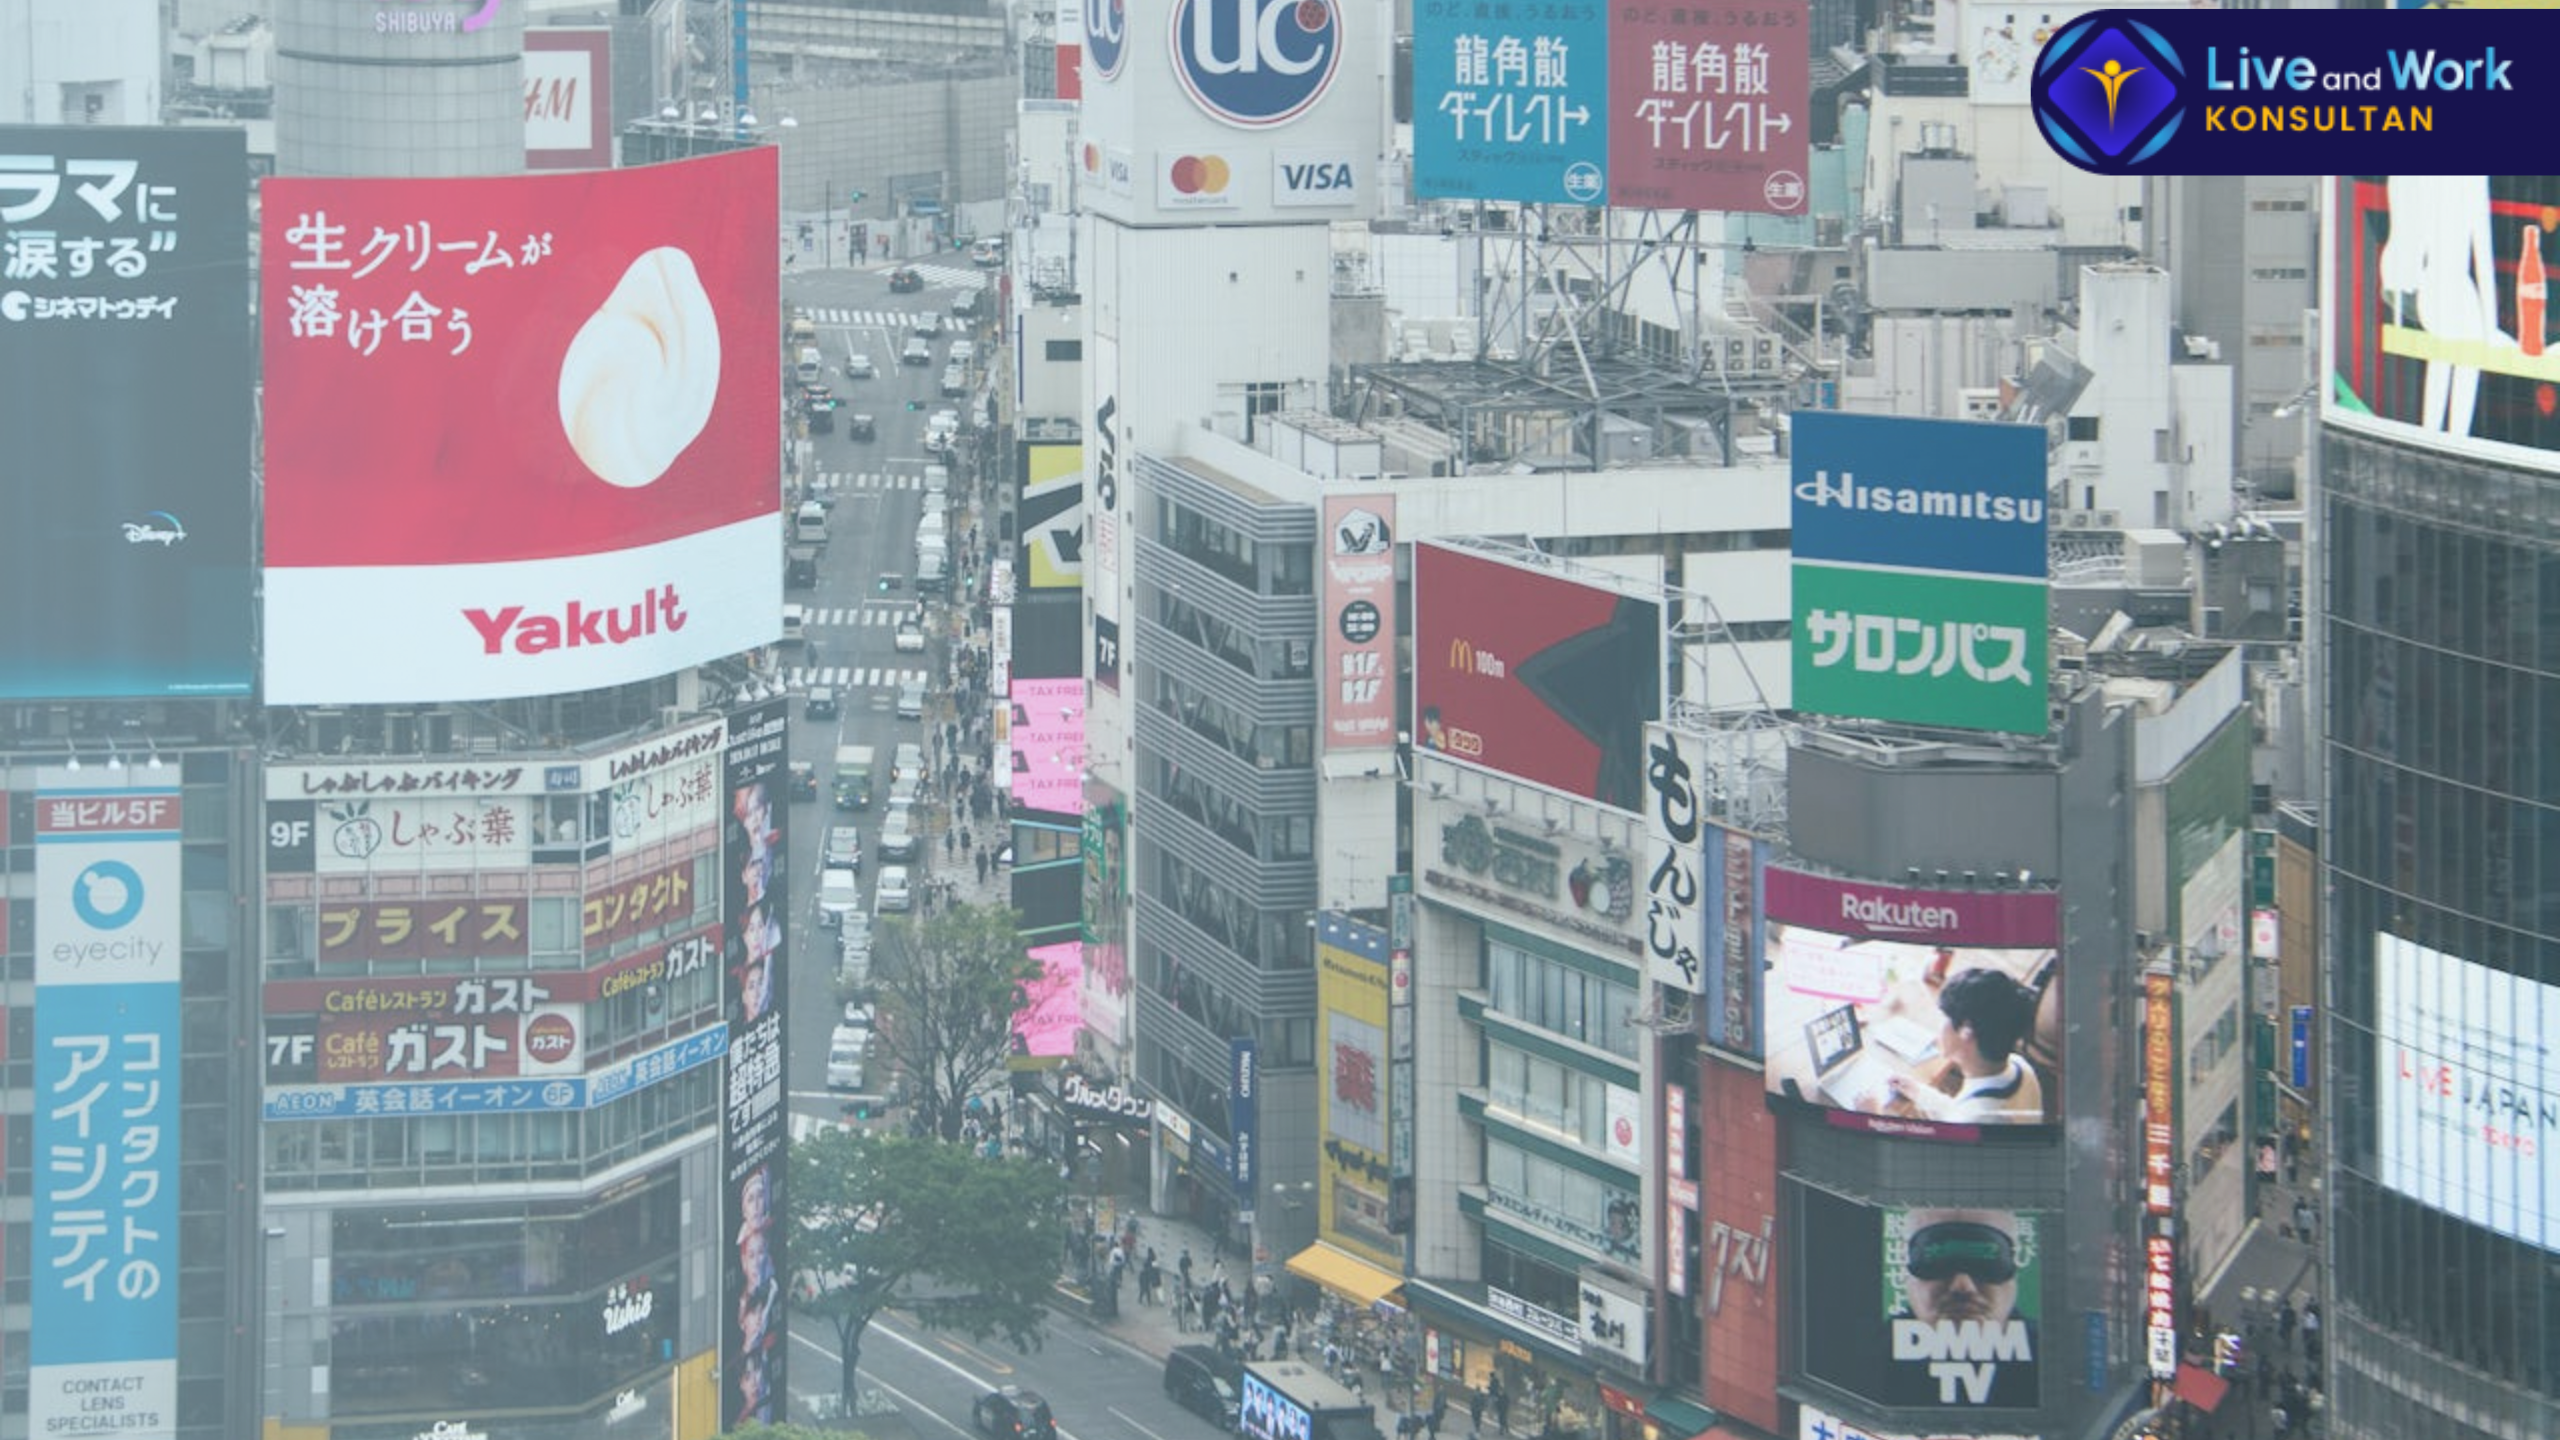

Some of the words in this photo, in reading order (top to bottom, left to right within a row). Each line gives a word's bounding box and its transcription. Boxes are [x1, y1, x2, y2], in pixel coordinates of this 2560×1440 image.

[375, 11, 455, 32] SHIBUYA
[1455, 34, 1569, 87] 龍角散
[1652, 40, 1770, 94] 龍角散
[1439, 91, 1590, 144] ダイレクト
[1634, 99, 1792, 152] ダイレクト
[1281, 163, 1353, 190] VISA
[285, 211, 552, 280] 生クリームが
[288, 284, 473, 356] 溶け合う
[1795, 470, 2043, 524] Hisamitsu
[461, 582, 688, 655] Yakult
[1100, 637, 1116, 667] 7F
[1806, 608, 2034, 687] サロンパス
[610, 726, 722, 780] しゃぶしゃぶバイキング
[302, 768, 523, 794] しゃぶしゃぶバイキング
[51, 800, 167, 828] 当ビル5F
[270, 821, 309, 847] 9F
[391, 807, 515, 846] しゃぶ葉
[1648, 733, 1698, 985] もんじゃ
[585, 869, 689, 935] コンタクト
[1841, 893, 1958, 929] Rakuten
[322, 905, 519, 947] プライス
[52, 936, 163, 969] eyecity
[666, 936, 715, 981] ガスト
[454, 978, 550, 1014] ガスト
[267, 1035, 314, 1065] 7F
[325, 1032, 380, 1054] Café
[327, 1054, 380, 1069] レストラン
[386, 1024, 507, 1073] ガスト
[532, 1035, 571, 1050] ガスト
[2400, 1049, 2453, 1097] LVE
[355, 1086, 532, 1113] 英会話イーオン
[1065, 1073, 1150, 1118] グルメタウン
[50, 1035, 110, 1302] アイシティ
[117, 1033, 161, 1300] コンタクトの
[1893, 1319, 2032, 1361] DMM
[63, 1376, 144, 1394] CONTACT
[81, 1396, 125, 1412] LENS
[1929, 1362, 1996, 1404] TV
[47, 1413, 159, 1432] SPECIALISTS
